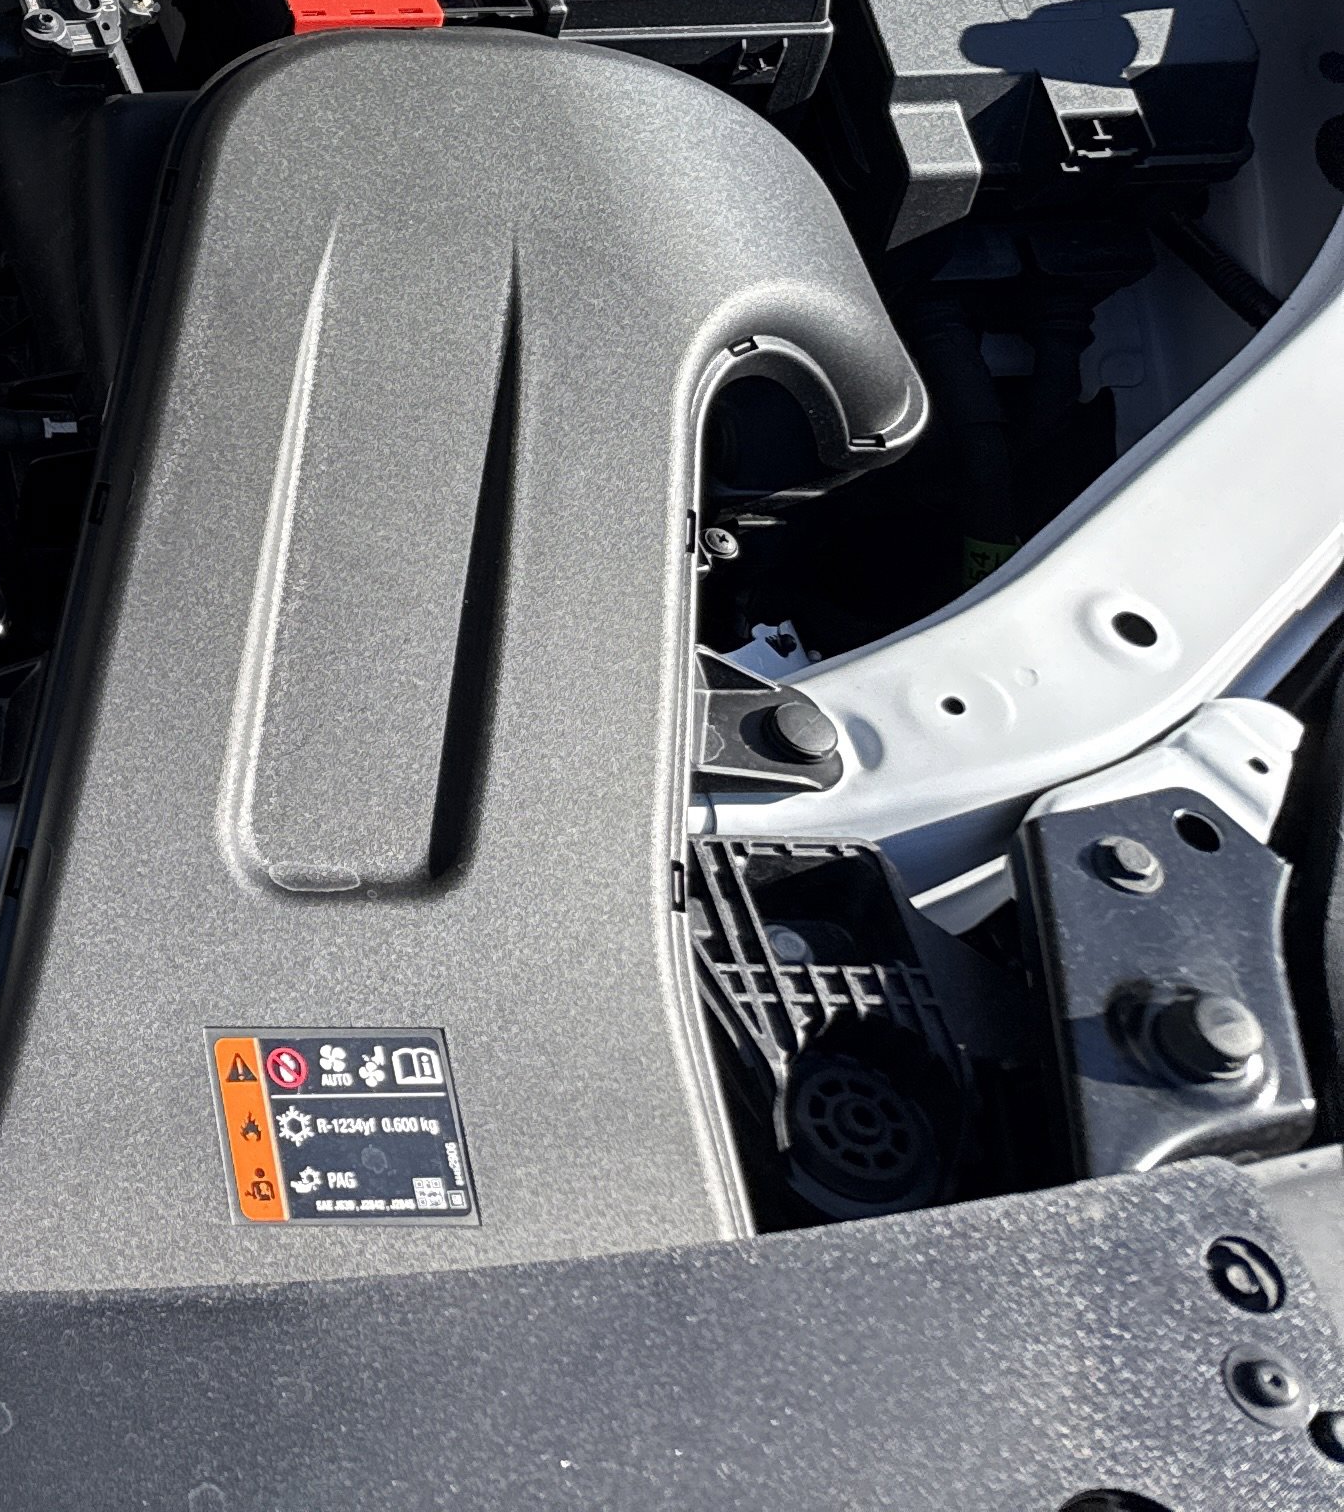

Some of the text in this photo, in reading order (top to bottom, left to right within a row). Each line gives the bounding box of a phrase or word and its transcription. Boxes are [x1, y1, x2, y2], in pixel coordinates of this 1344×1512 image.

[321, 1074, 352, 1086] AUTO
[316, 1118, 440, 1136] R-1234yf 0.600 kg
[326, 1171, 357, 1189] PAG
